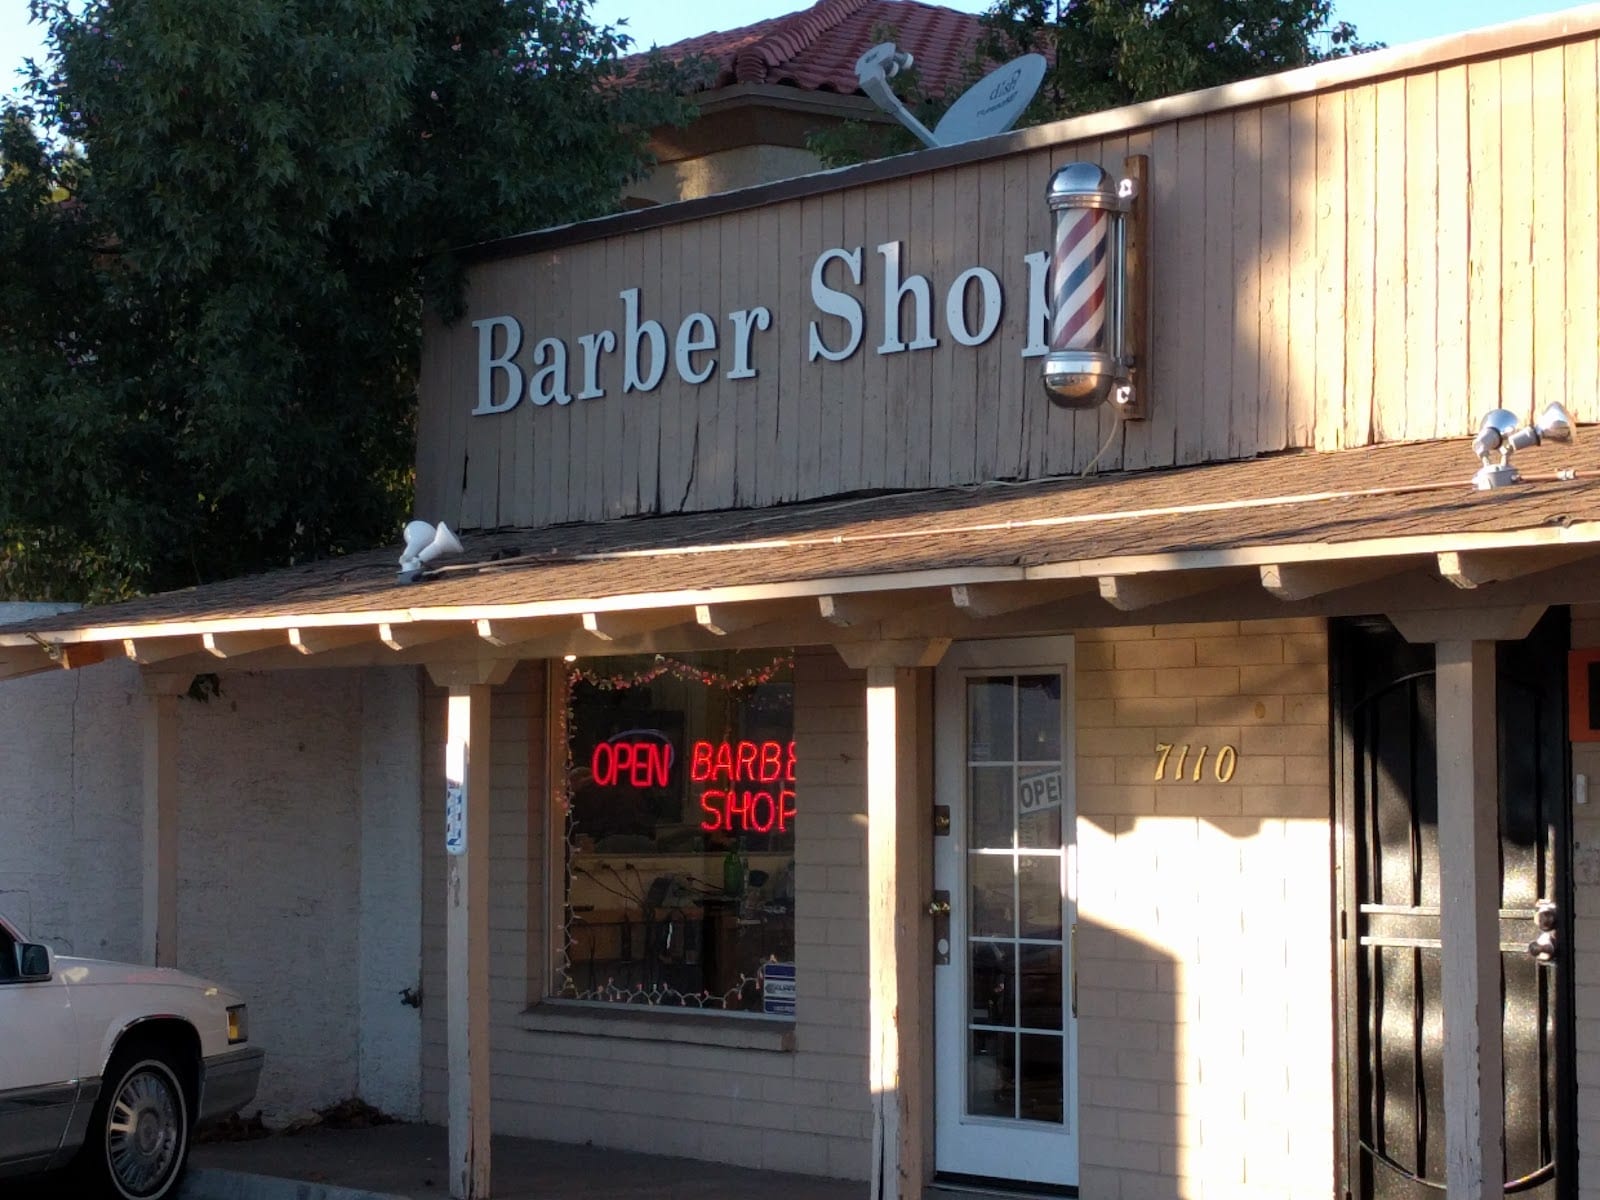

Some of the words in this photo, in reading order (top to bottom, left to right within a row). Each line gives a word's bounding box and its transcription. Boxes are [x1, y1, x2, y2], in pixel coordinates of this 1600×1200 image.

[472, 287, 771, 416] Barber
[592, 742, 671, 788] OPEN
[1154, 743, 1238, 783] 7110
[701, 789, 797, 833] SHOP
